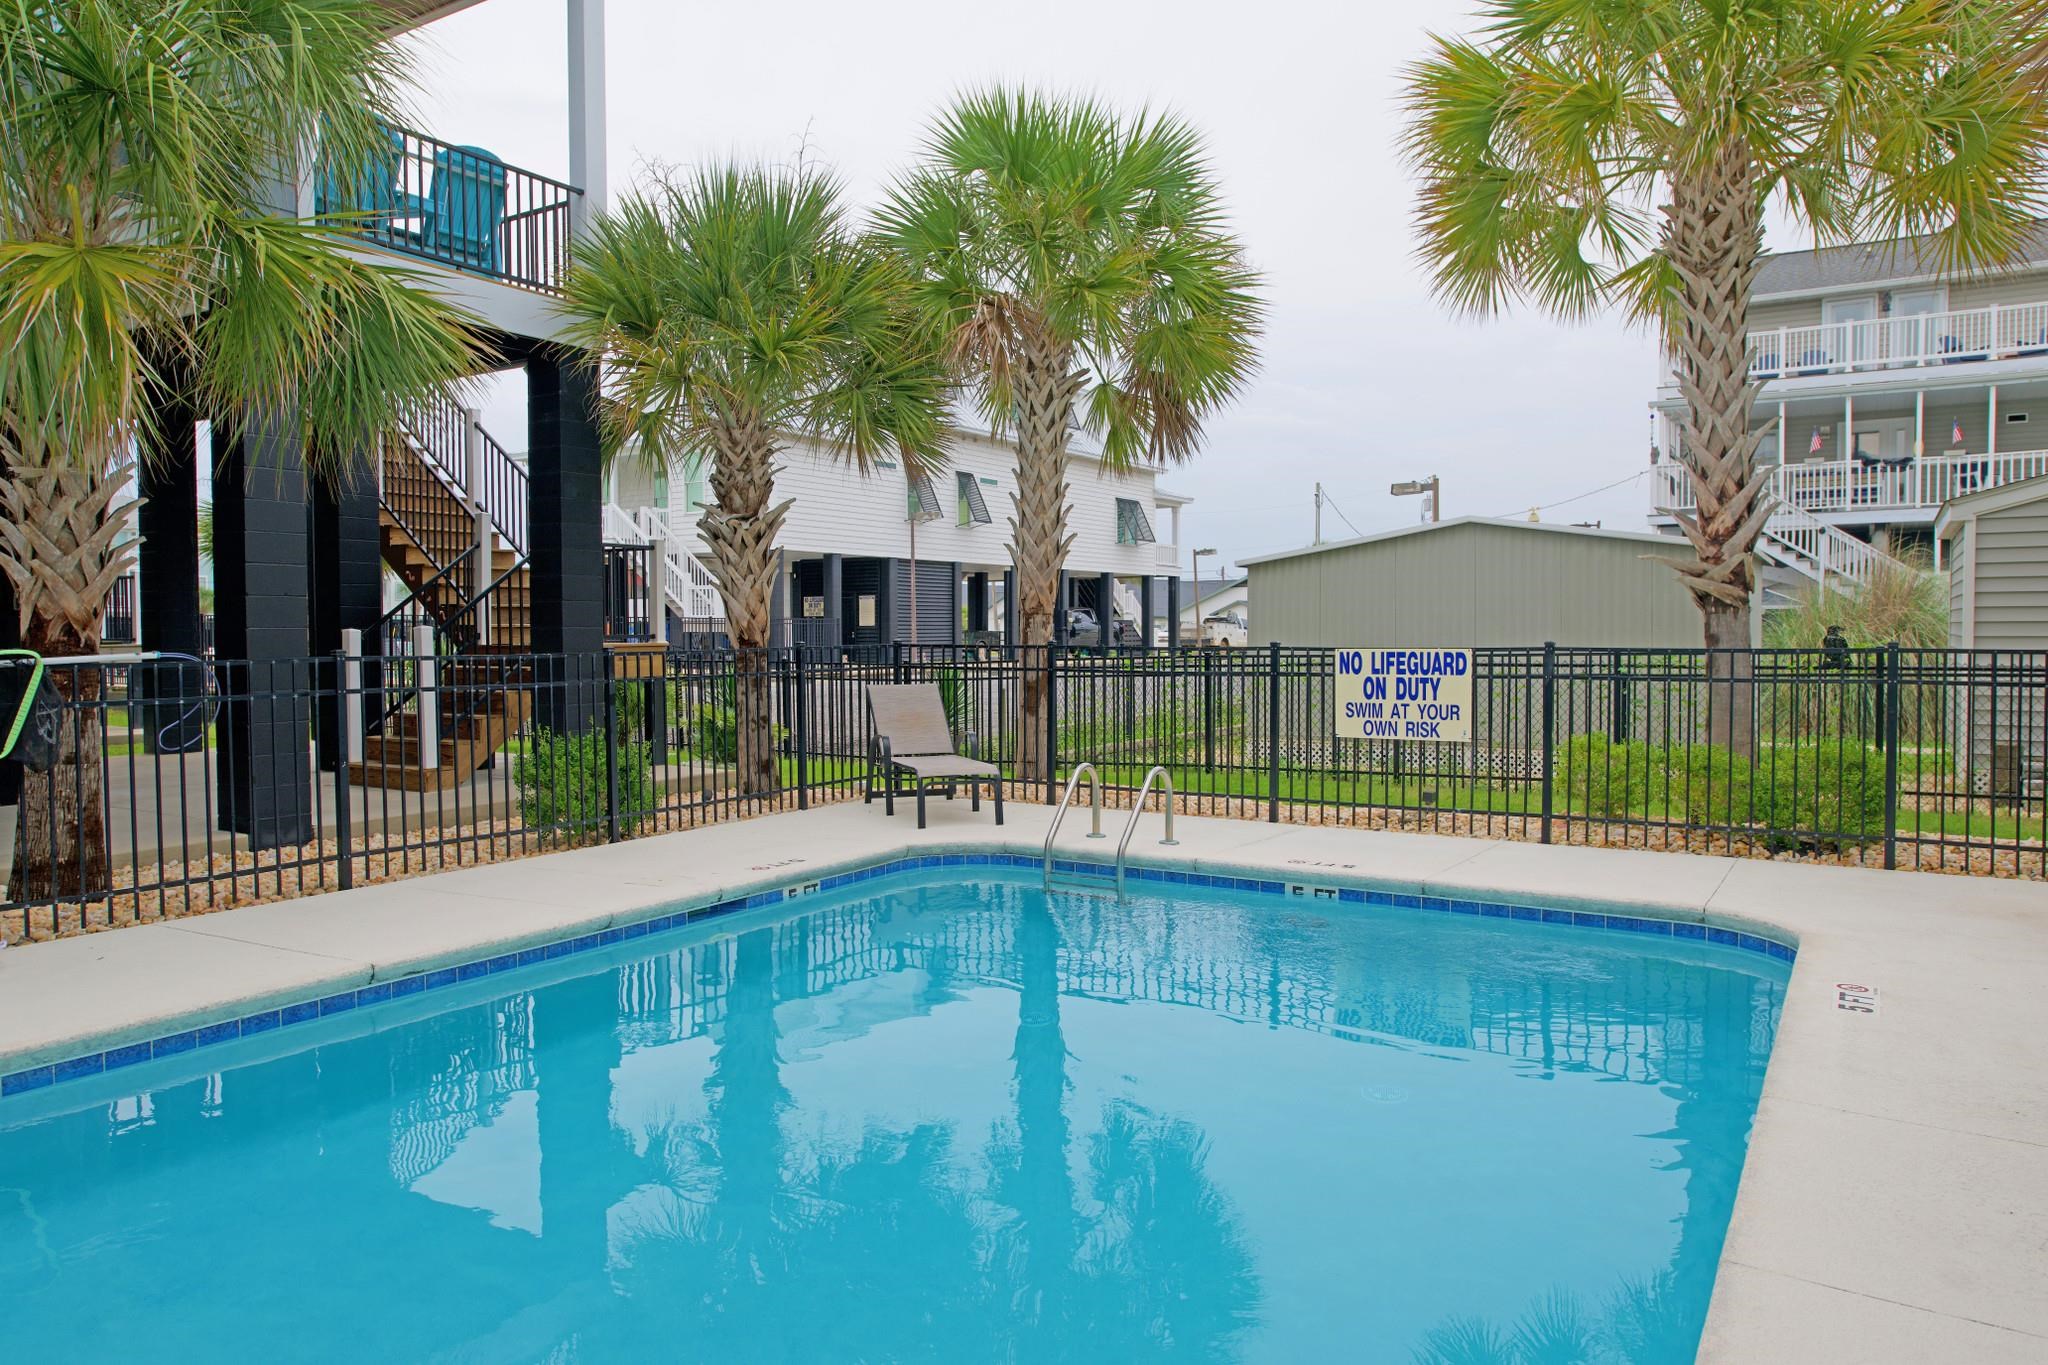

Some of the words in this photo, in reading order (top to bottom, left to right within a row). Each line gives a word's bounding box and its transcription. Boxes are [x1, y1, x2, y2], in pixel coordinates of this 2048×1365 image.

[1339, 651, 1363, 675] NO
[1371, 651, 1468, 676] LIFEGUARD
[1363, 676, 1387, 700] ON
[1395, 677, 1441, 701] DUTY
[1345, 702, 1383, 718] SWIM
[1390, 703, 1410, 719] AT
[1417, 704, 1461, 721] YOUR
[1363, 720, 1398, 737] OWN
[1405, 721, 1441, 738] RISK
[1838, 991, 1876, 1006] FT
[1838, 1003, 1875, 1014] 5
